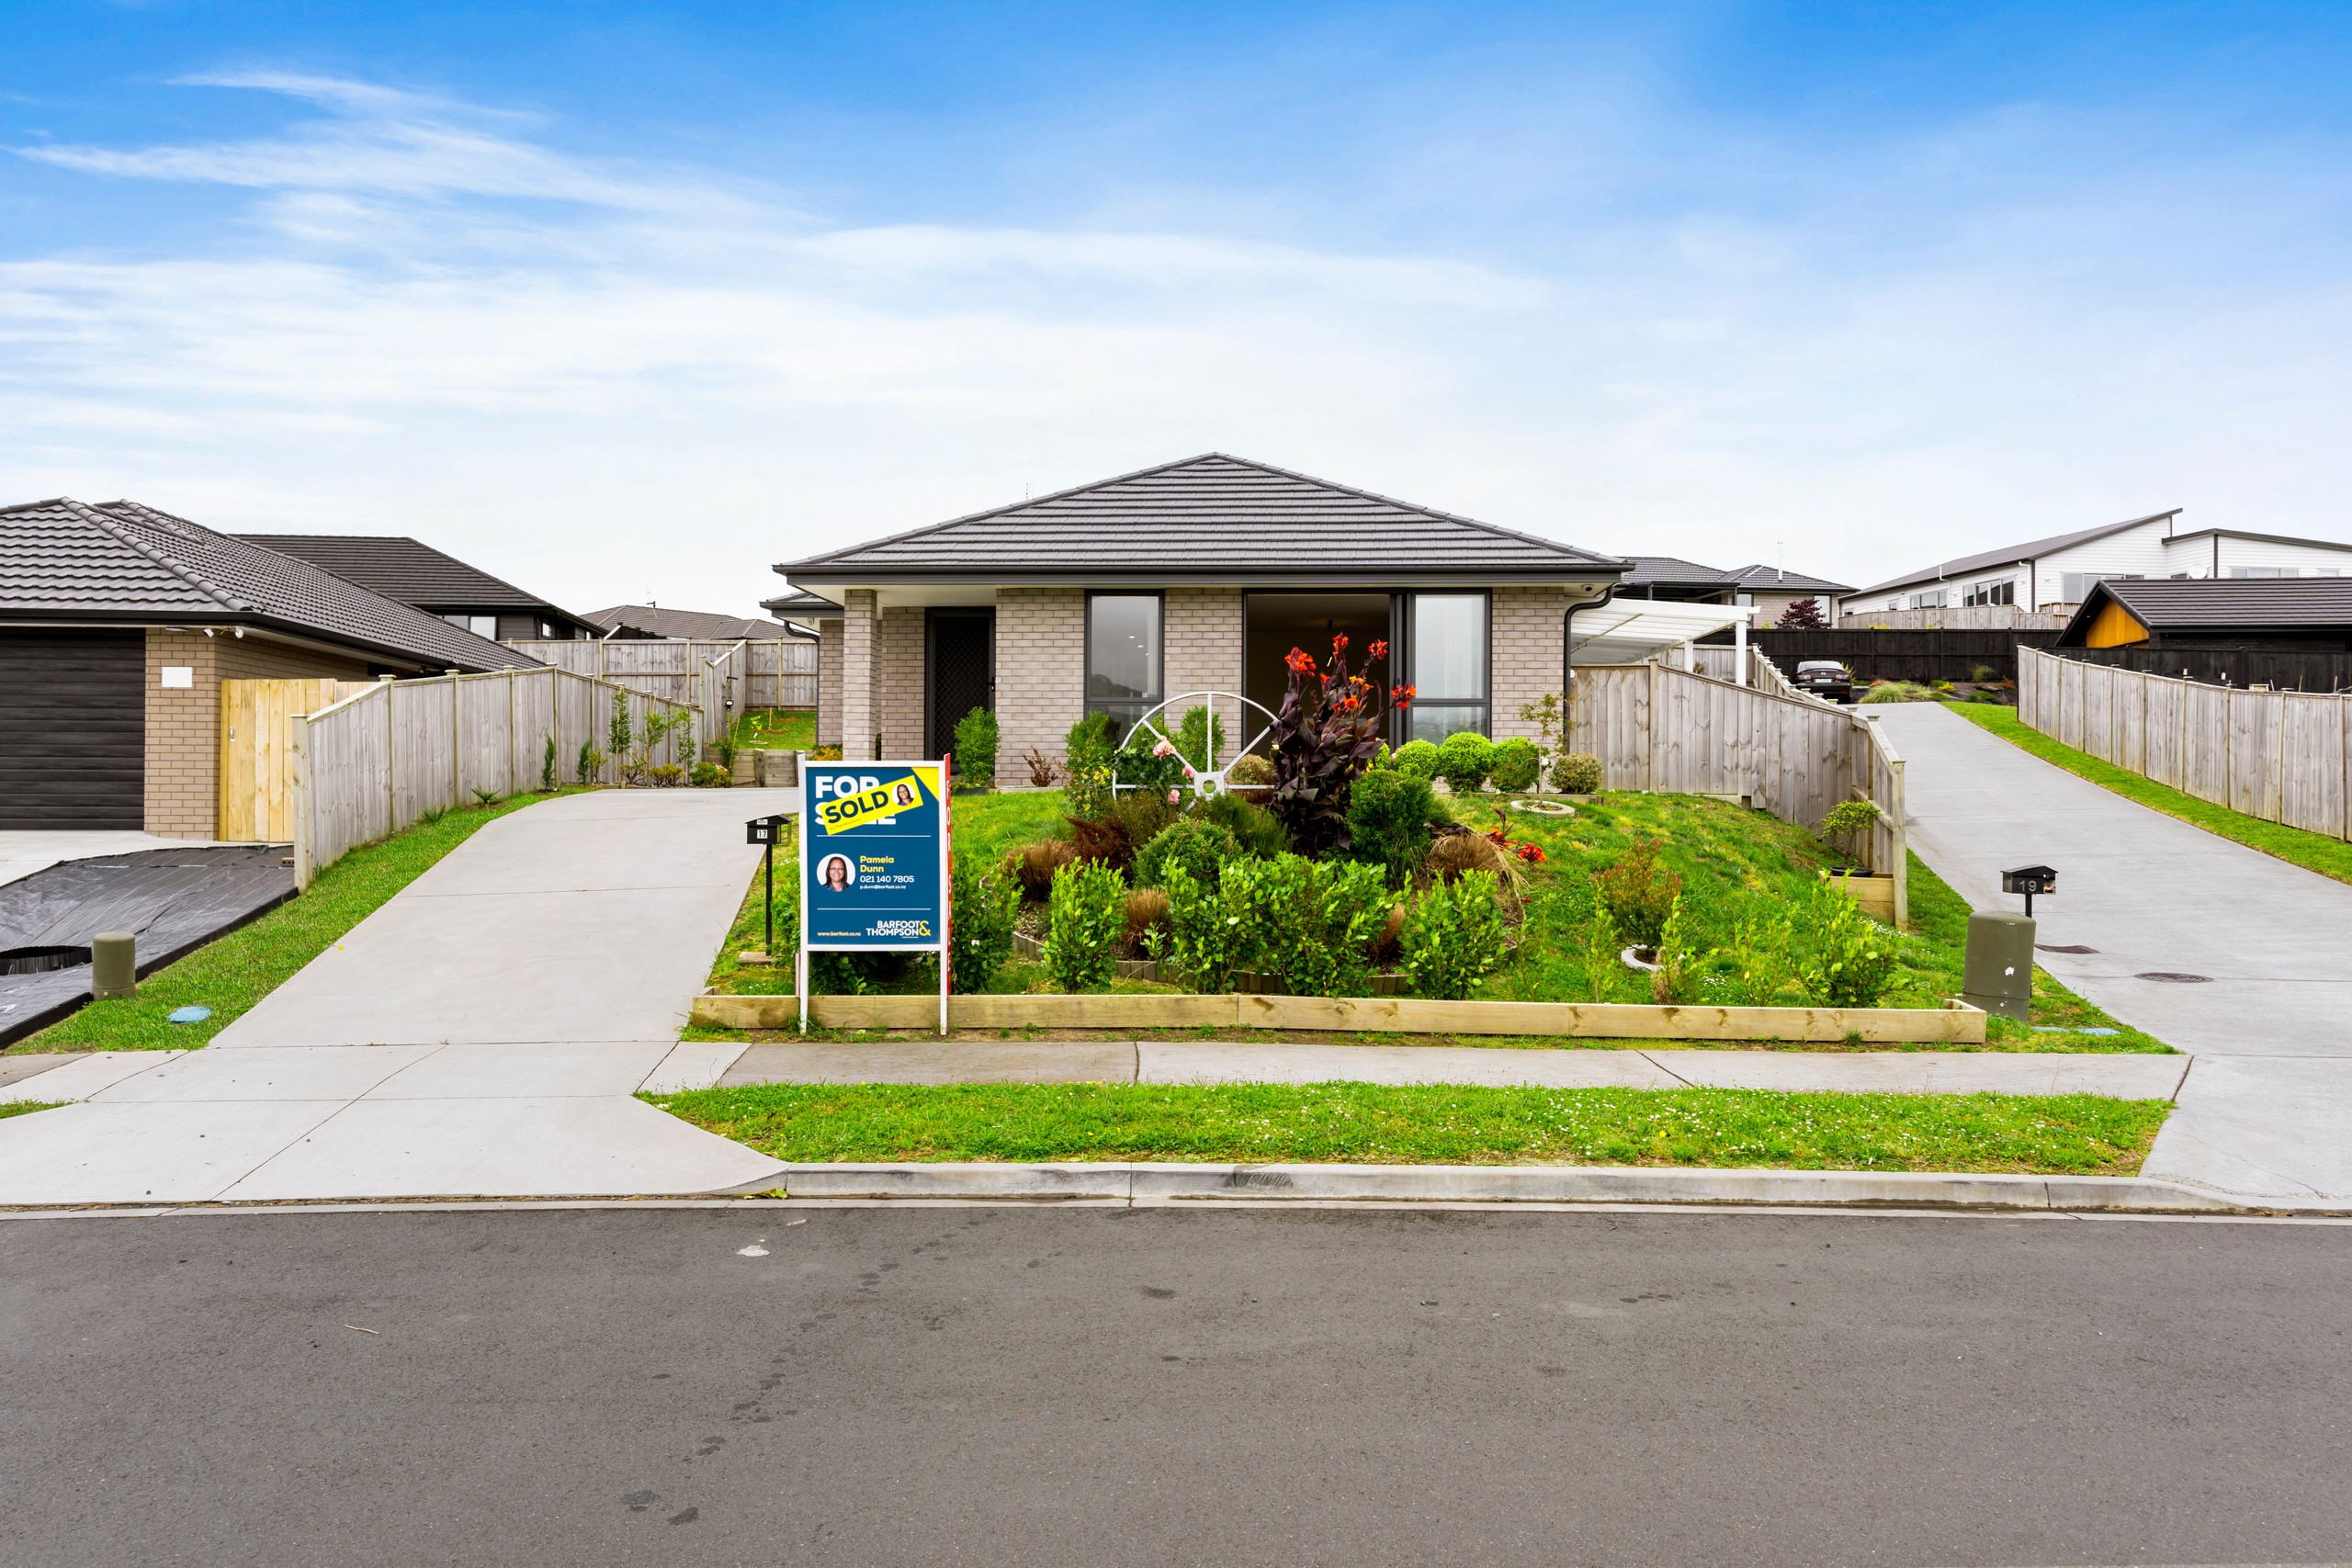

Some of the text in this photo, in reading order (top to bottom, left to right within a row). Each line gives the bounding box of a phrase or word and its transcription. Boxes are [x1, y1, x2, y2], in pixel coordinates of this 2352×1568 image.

[825, 791, 888, 824] SOLD
[859, 855, 895, 863] Pamela
[859, 864, 885, 873] Dunn
[2019, 880, 2037, 892] 19
[865, 928, 919, 936] THOMPSON
[876, 919, 931, 936] BARFOOT &
